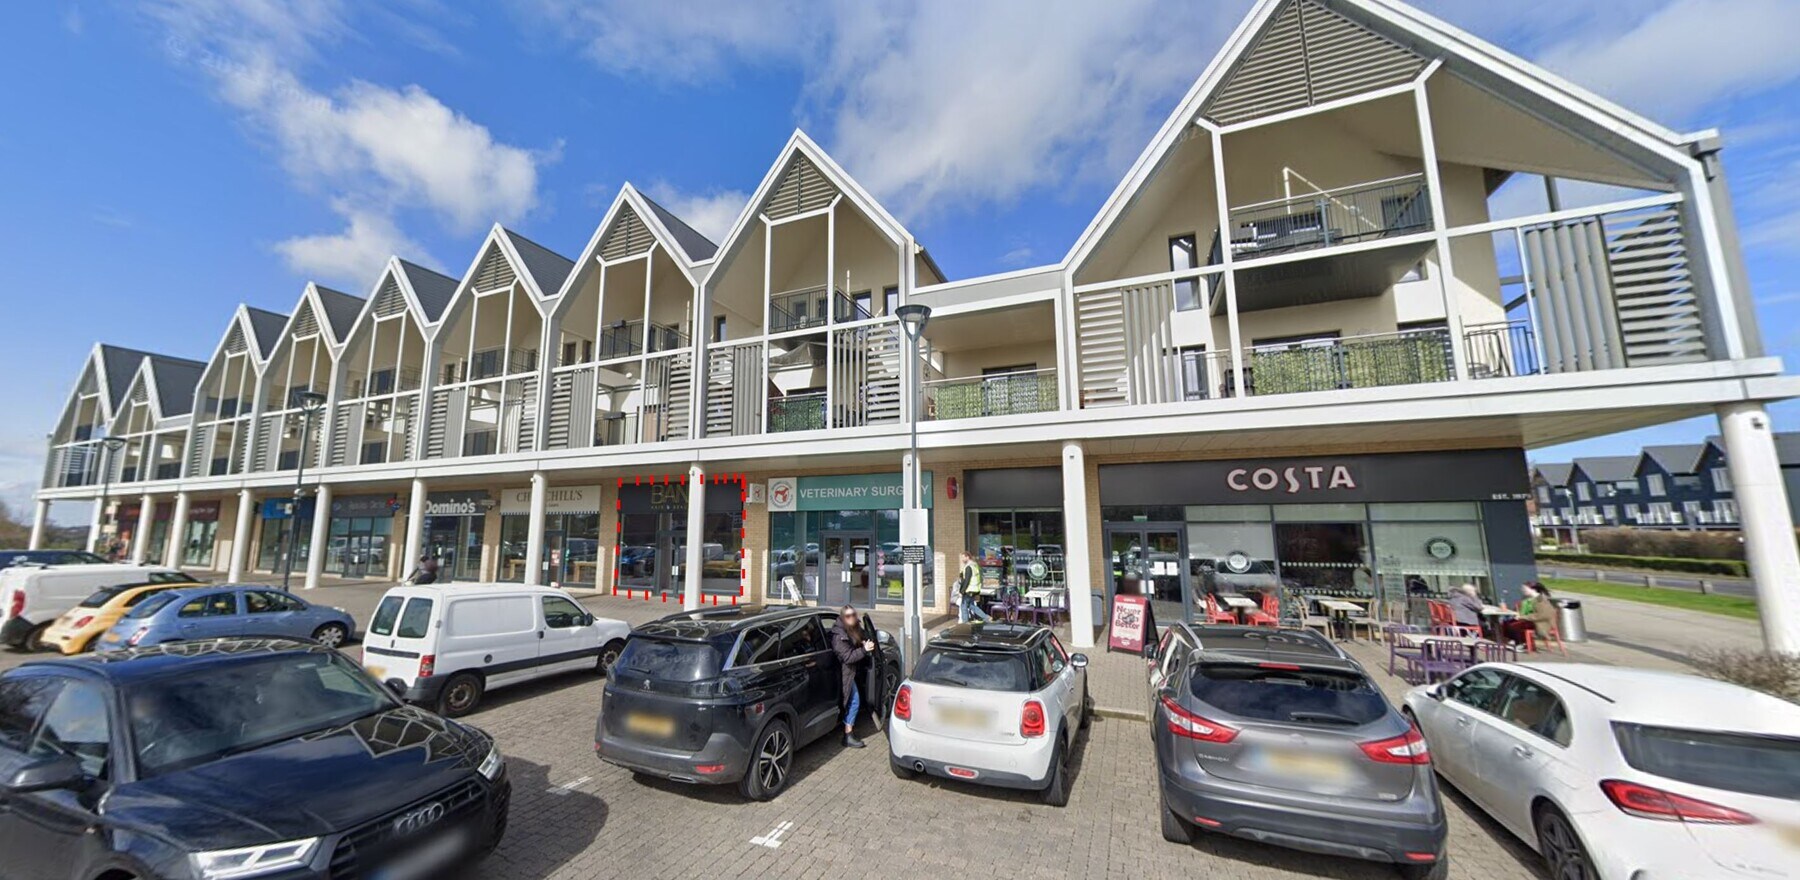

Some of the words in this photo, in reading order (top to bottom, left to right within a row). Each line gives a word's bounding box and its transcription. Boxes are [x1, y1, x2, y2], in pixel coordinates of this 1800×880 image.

[1226, 465, 1356, 493] COSTA
[516, 489, 583, 502] CHCHILL'S
[651, 484, 689, 504] BAN
[799, 486, 868, 499] VETERINARY
[871, 484, 929, 496] SURGY
[424, 498, 476, 514] Domino's
